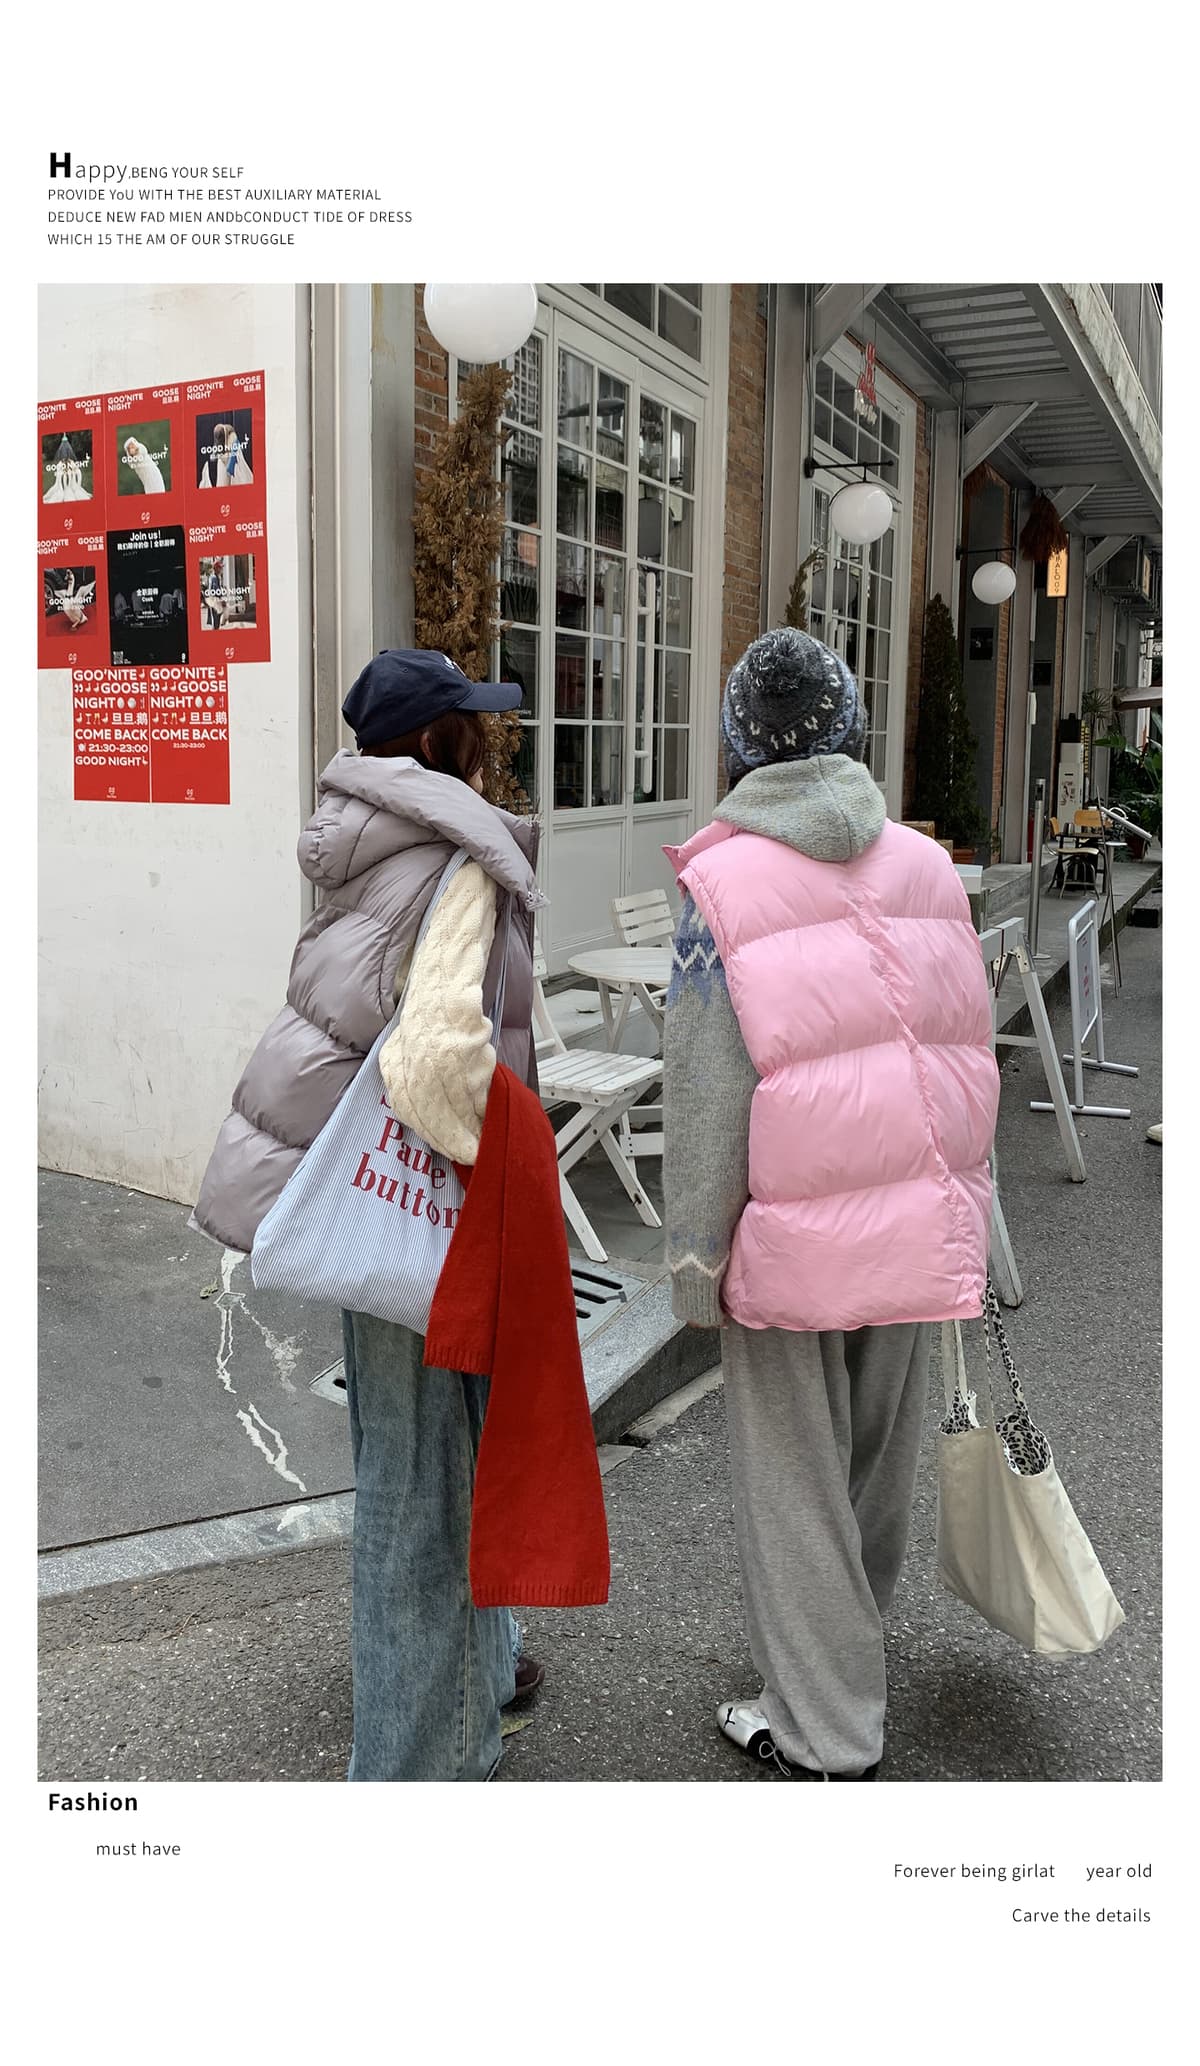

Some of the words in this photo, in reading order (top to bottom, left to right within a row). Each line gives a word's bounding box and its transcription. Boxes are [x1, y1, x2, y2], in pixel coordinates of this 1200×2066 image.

[233, 376, 261, 386] GOOSE
[187, 381, 223, 393] GOO'NITE
[152, 388, 178, 398] GOOSE
[187, 391, 211, 400] NIGHT
[75, 399, 101, 408] GOOSE
[108, 393, 143, 404] GOO'NITE
[108, 402, 131, 412] NIGHT
[201, 445, 223, 454] GOOD
[146, 452, 167, 460] IGHT
[46, 463, 66, 471] GOD
[67, 461, 89, 470] NGHT
[189, 525, 226, 536] GOO'NITE
[235, 521, 263, 532] GOOSE
[78, 536, 104, 545] GOOSE
[130, 531, 147, 541] Join
[189, 534, 214, 543] NIGHT
[204, 588, 227, 596] GOOD
[228, 586, 251, 594] NIGHT
[49, 598, 70, 606] GOO
[73, 669, 137, 681] GOO'NITE
[150, 667, 216, 680] GOO'NITE
[101, 682, 147, 694] GOOSE
[178, 680, 227, 693] GOOSE
[74, 697, 116, 709] NIGHT
[151, 696, 193, 708] NIGHT
[75, 729, 112, 740] COME
[114, 729, 148, 741] BACK
[151, 729, 189, 740] COME
[192, 729, 227, 740] BACK
[88, 744, 149, 753] 21:30-23:00
[75, 756, 106, 765] GOOD
[108, 756, 142, 766] NIGHT
